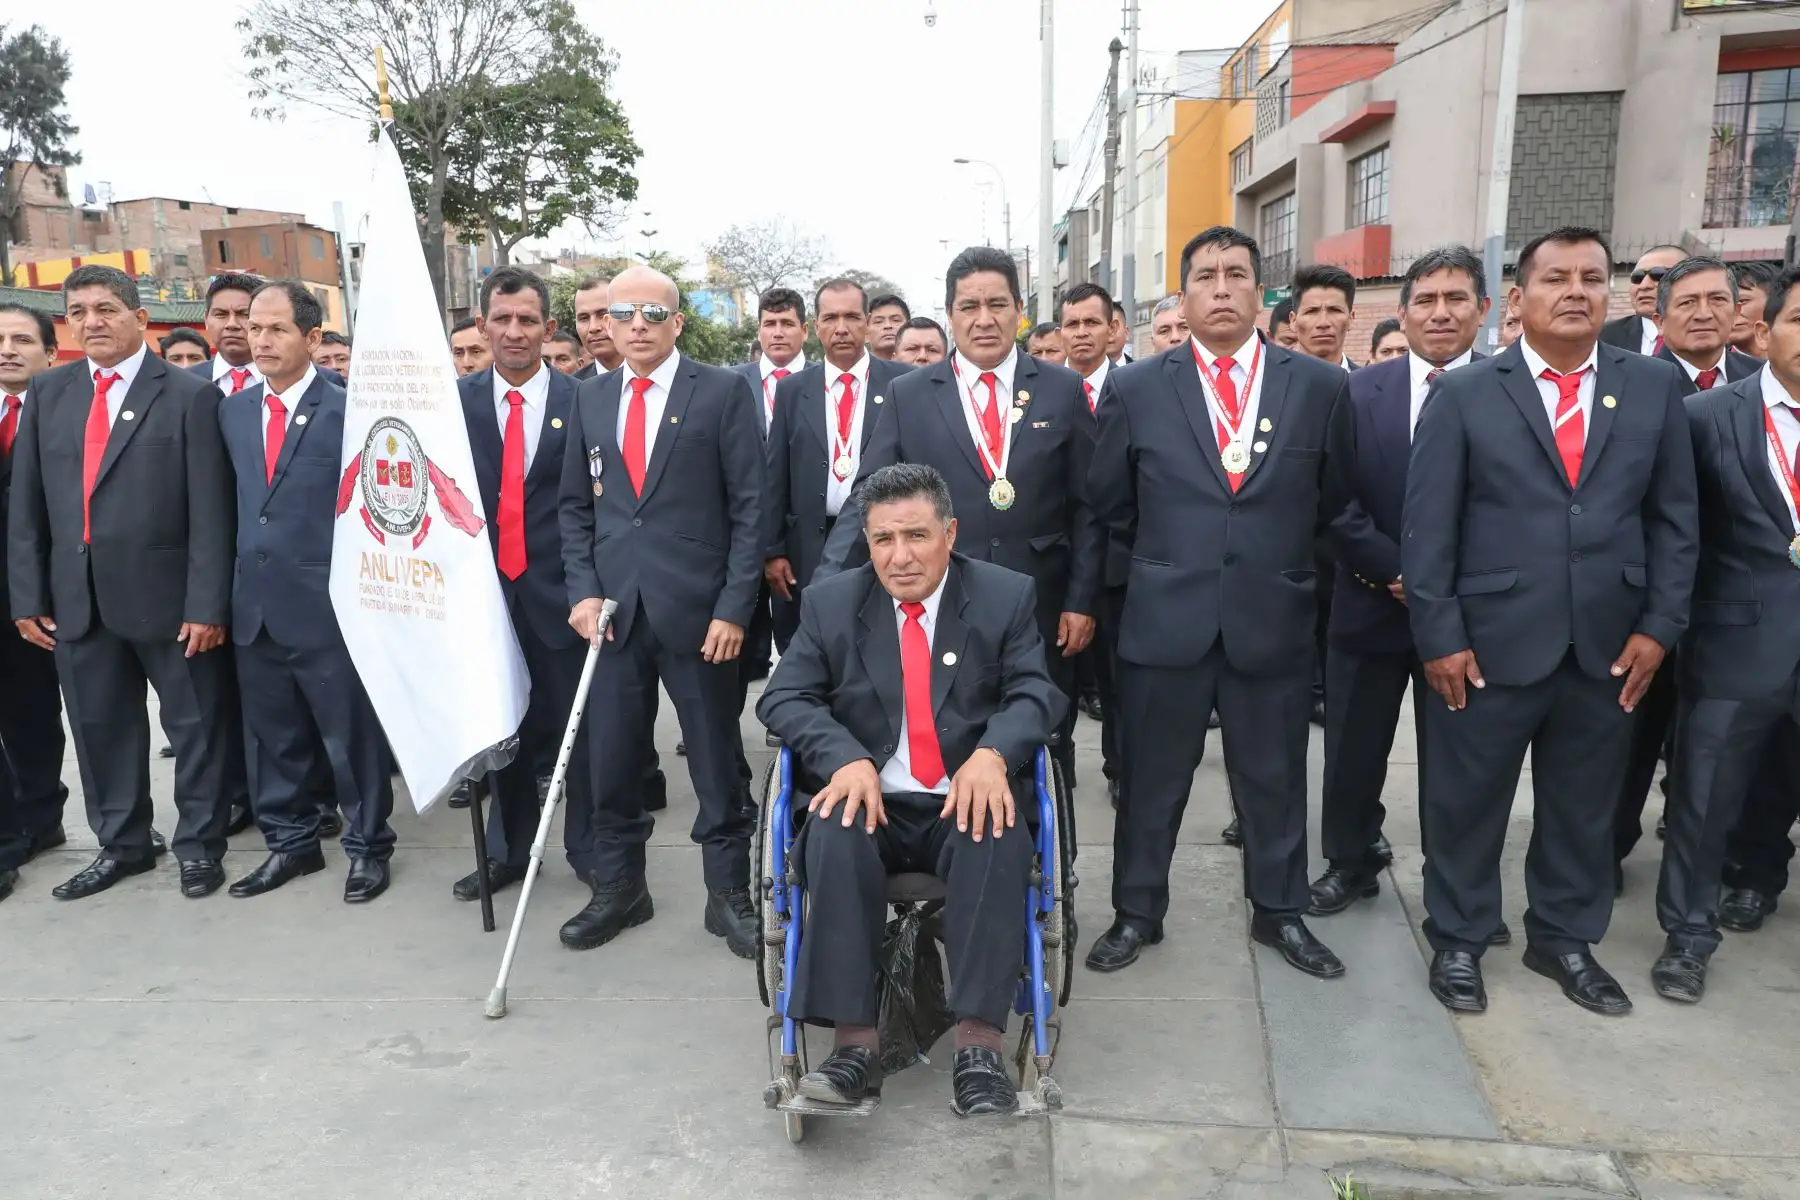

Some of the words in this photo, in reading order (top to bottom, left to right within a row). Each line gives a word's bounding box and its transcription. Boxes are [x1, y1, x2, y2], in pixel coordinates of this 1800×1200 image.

[407, 382, 419, 394] DEL
[385, 522, 412, 534] ANLIVEPA
[359, 551, 445, 589] ANLIVEPA
